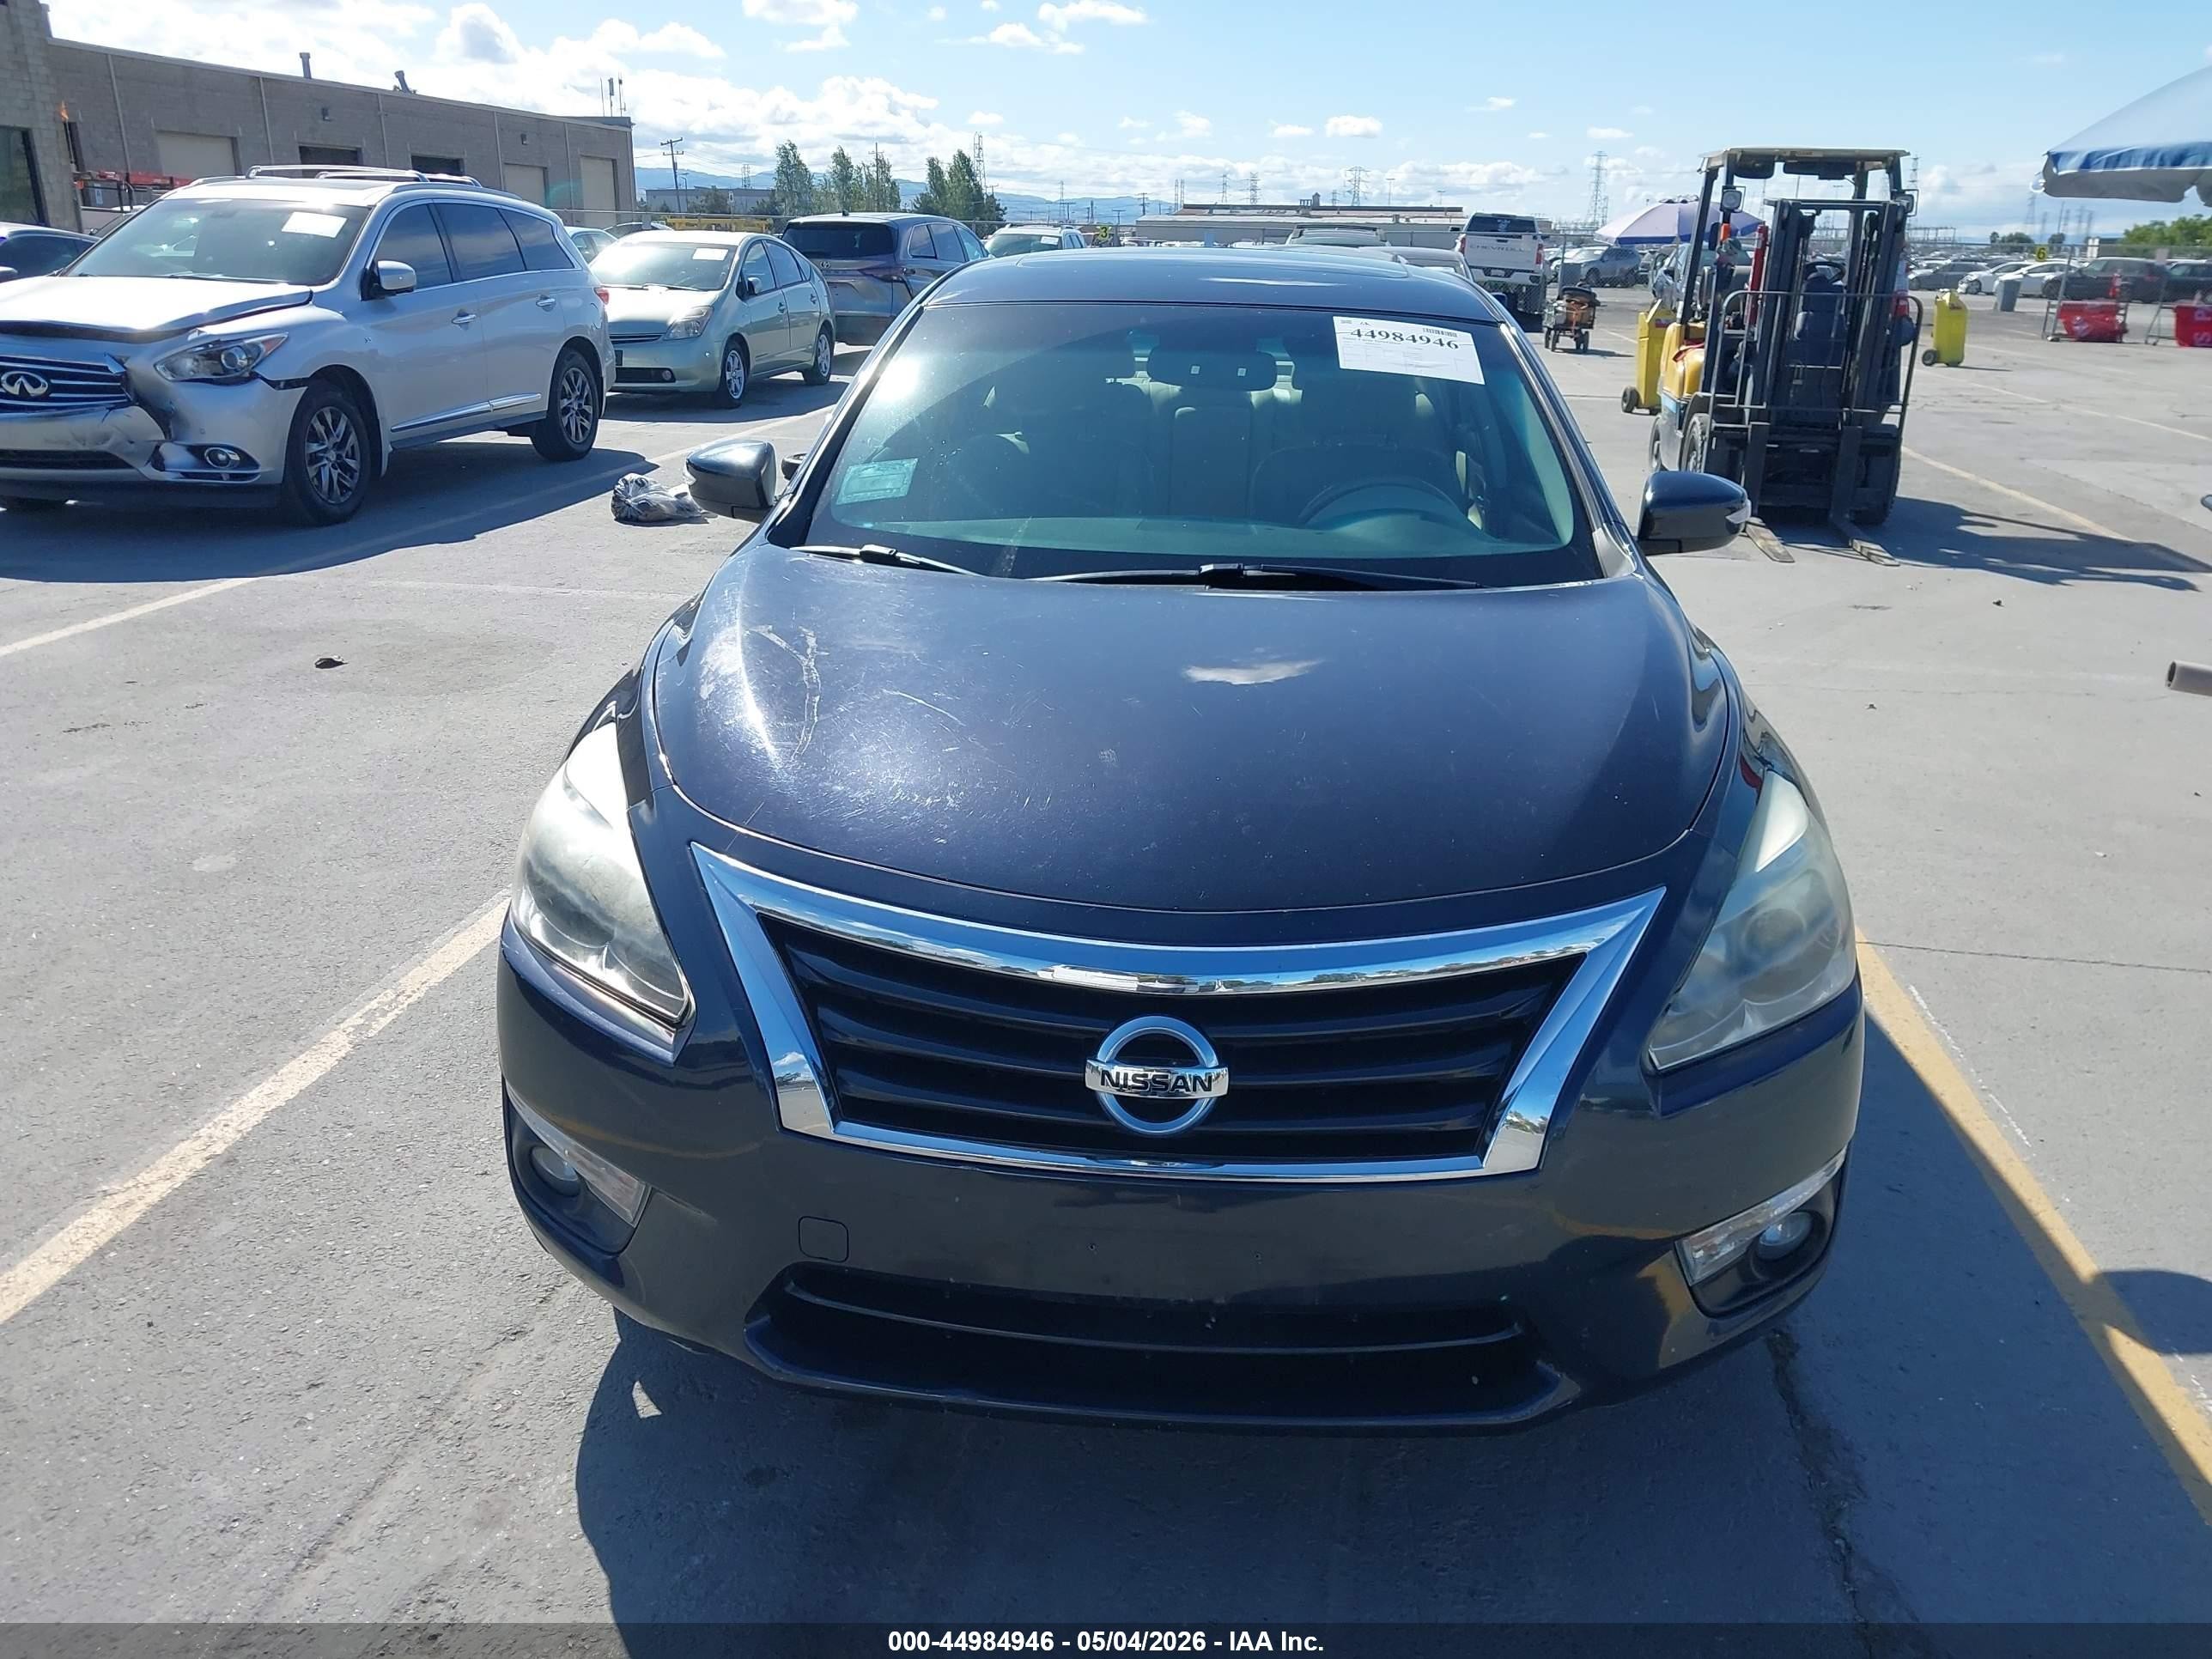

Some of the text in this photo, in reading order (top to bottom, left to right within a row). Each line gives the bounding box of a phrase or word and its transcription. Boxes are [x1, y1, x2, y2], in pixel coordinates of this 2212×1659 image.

[1100, 226, 1108, 238] 3
[1469, 245, 1531, 253] CHEVROLE
[2037, 247, 2046, 259] 6
[1351, 328, 1459, 349] 44984946
[1100, 1070, 1212, 1092] NISSAN
